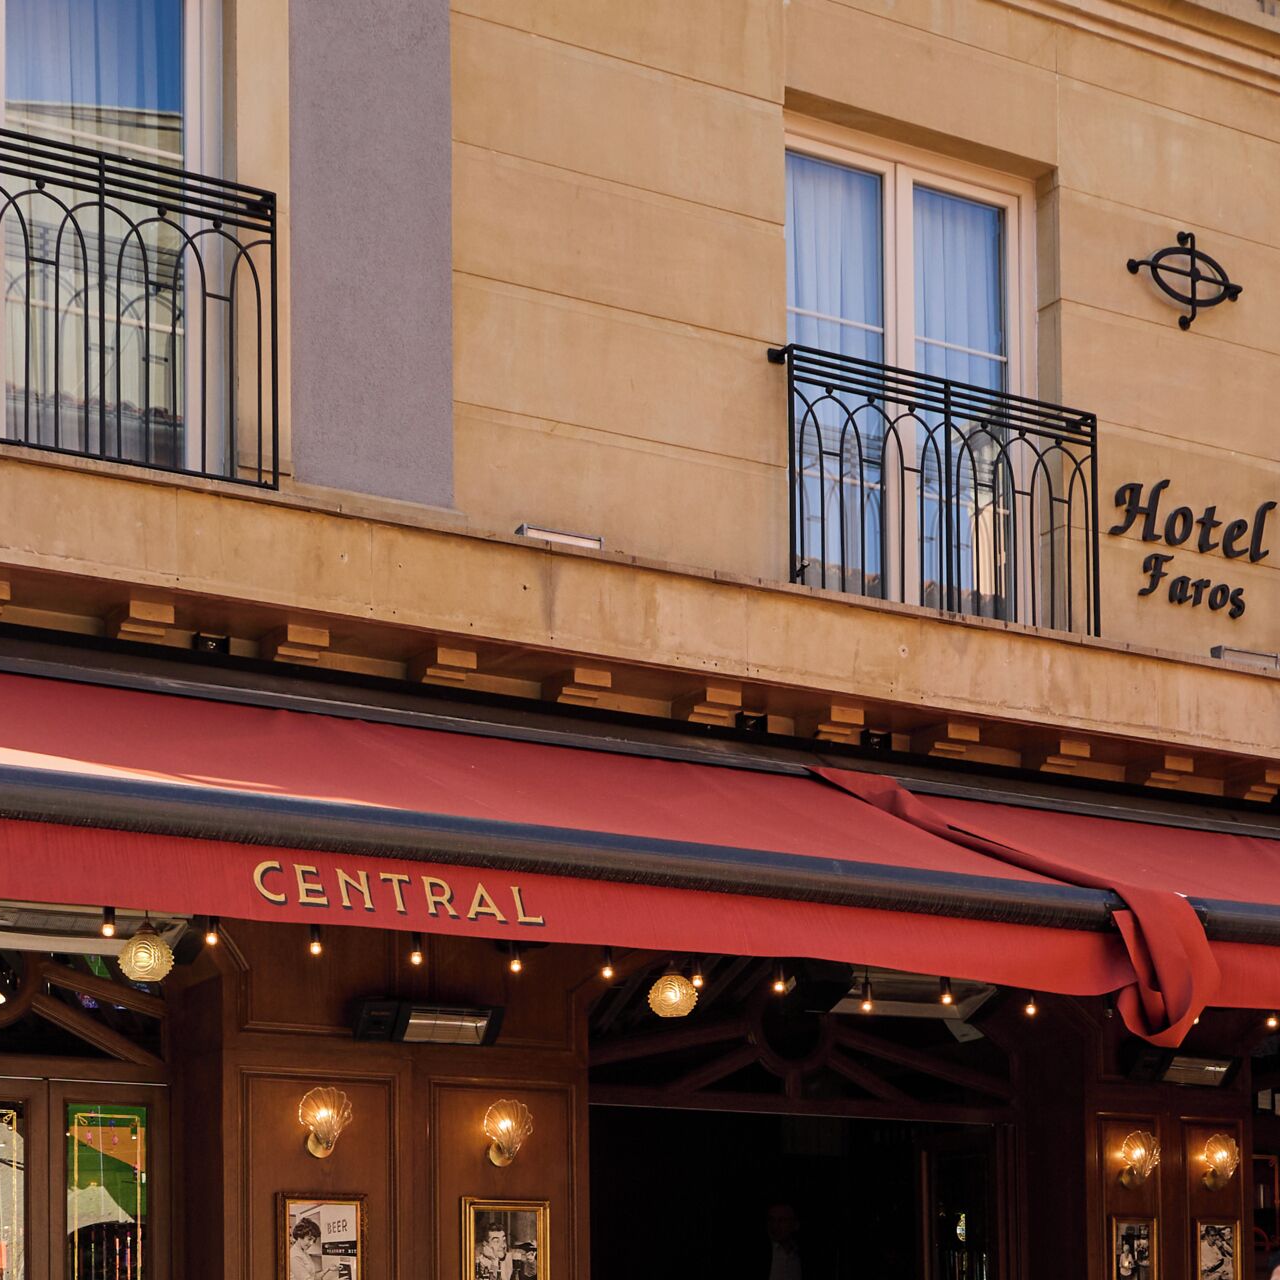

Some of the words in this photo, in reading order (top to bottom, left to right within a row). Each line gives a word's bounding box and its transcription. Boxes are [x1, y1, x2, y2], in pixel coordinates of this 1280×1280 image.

[1108, 479, 1278, 563] Hotel
[1137, 553, 1246, 620] Faros
[252, 860, 545, 926] CENTRAL
[327, 1219, 348, 1235] BEER
